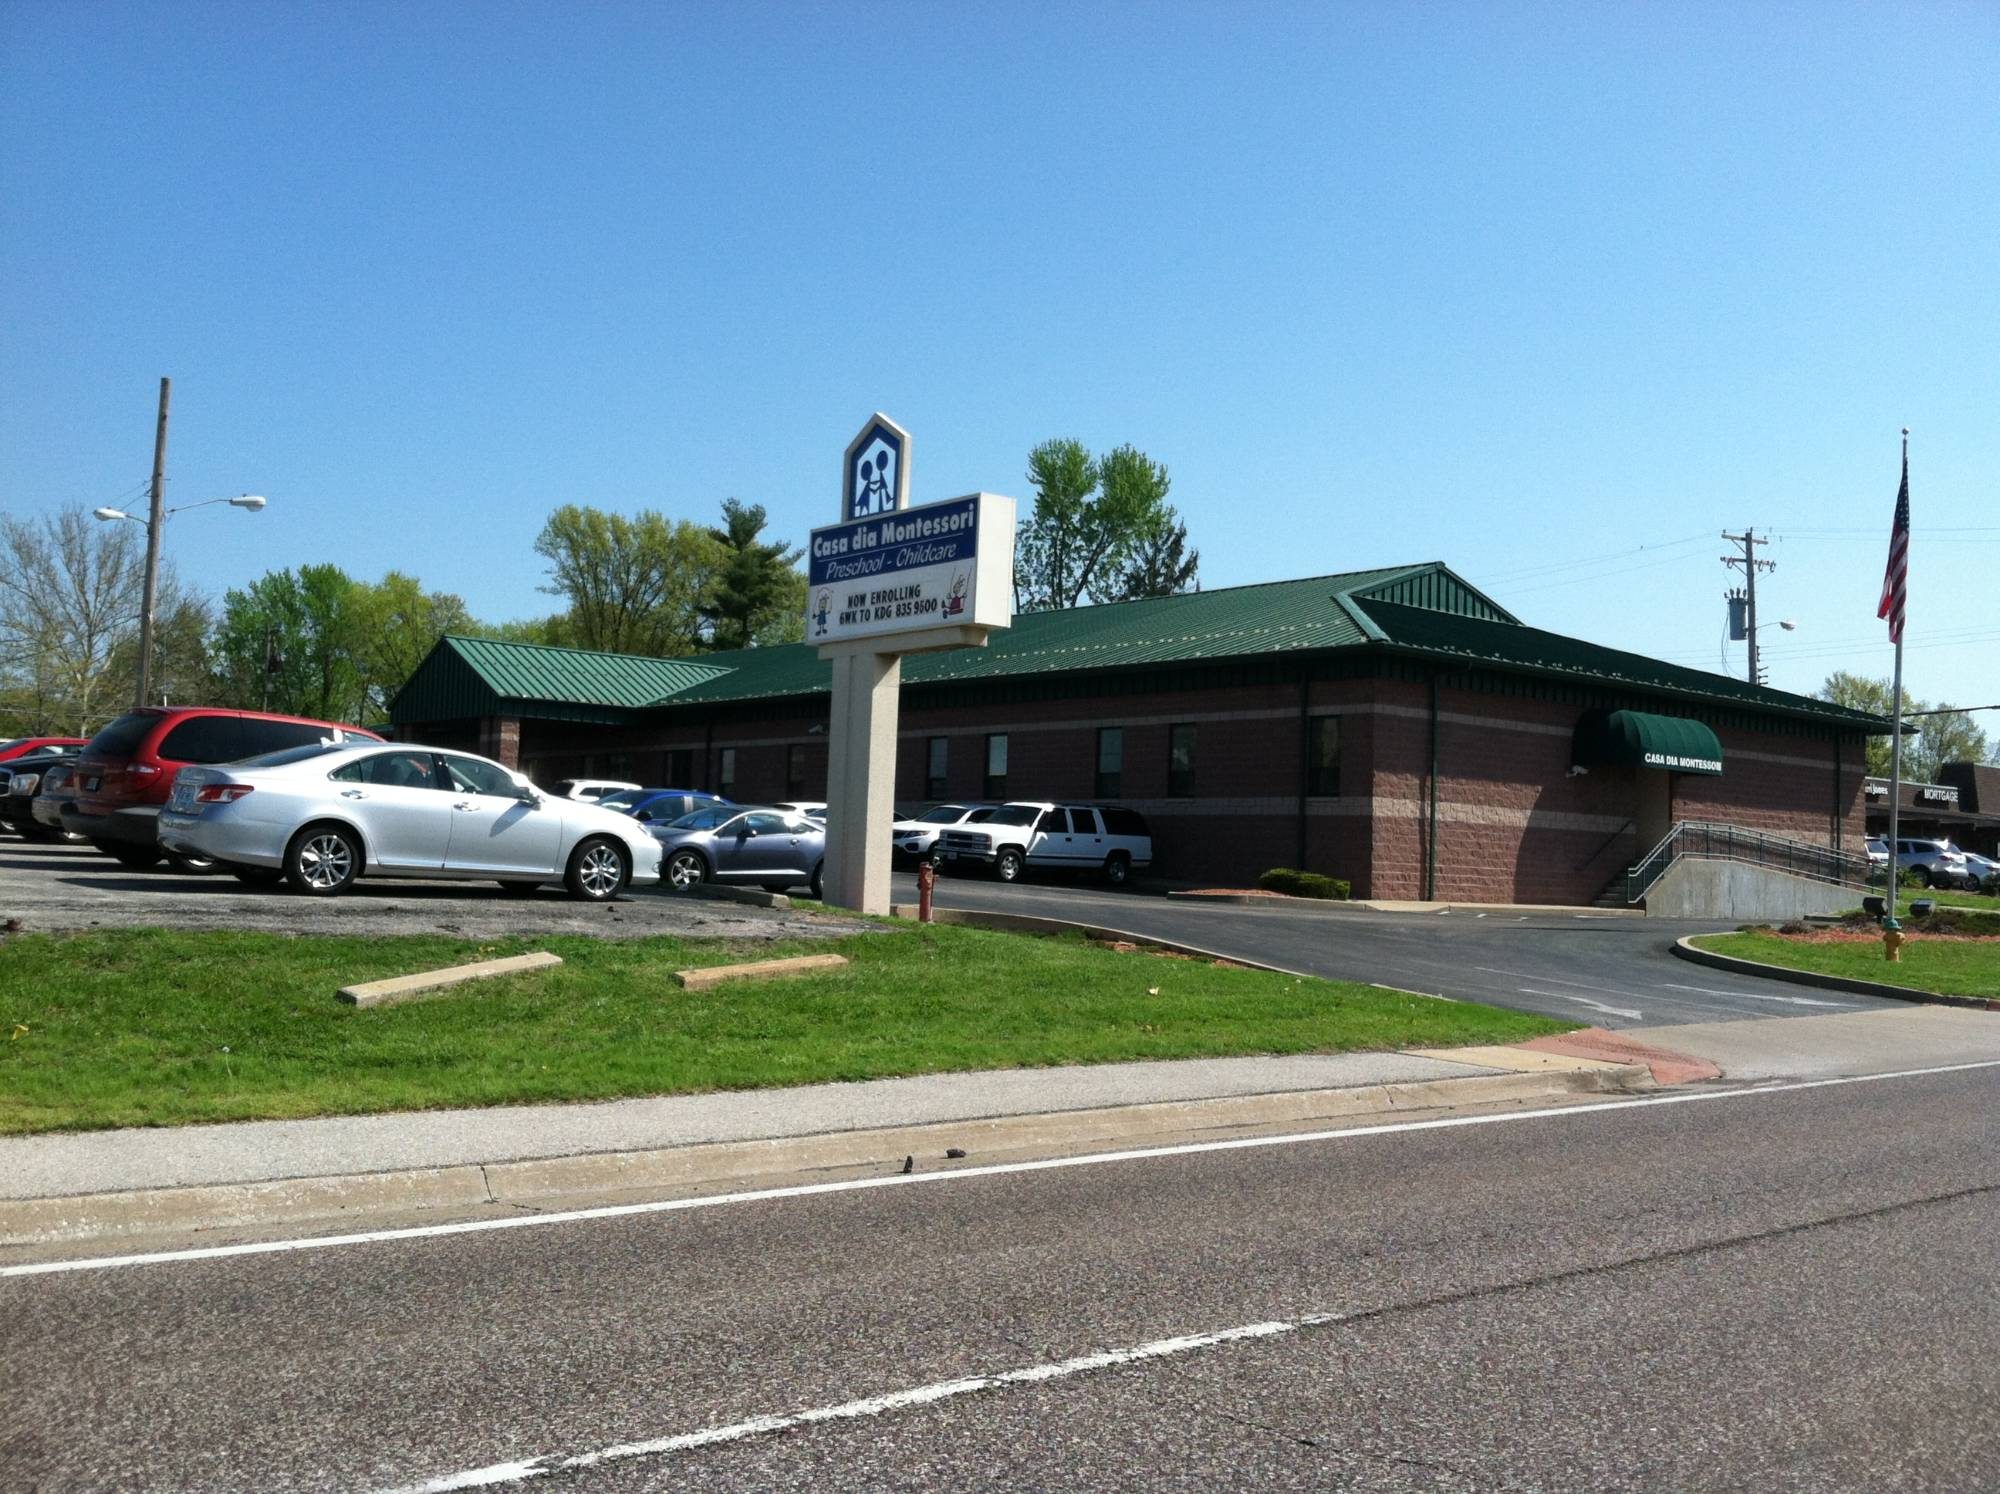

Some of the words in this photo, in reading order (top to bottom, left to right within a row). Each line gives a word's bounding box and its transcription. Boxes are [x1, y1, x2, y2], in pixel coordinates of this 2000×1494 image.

[813, 534, 848, 558] Casa
[852, 526, 878, 549] dia
[881, 503, 974, 545] Montessori
[826, 553, 885, 580] Preschool
[896, 543, 957, 566] Childcare
[848, 593, 866, 609] NOW
[870, 584, 921, 605] ENROLLING
[839, 609, 857, 625] 6WK
[860, 609, 871, 623] TO
[874, 605, 892, 620] KDG
[895, 602, 912, 617] 835
[1644, 753, 1665, 765] CASA
[1666, 755, 1678, 766] DIA
[1924, 788, 1959, 802] MORTGAGE
